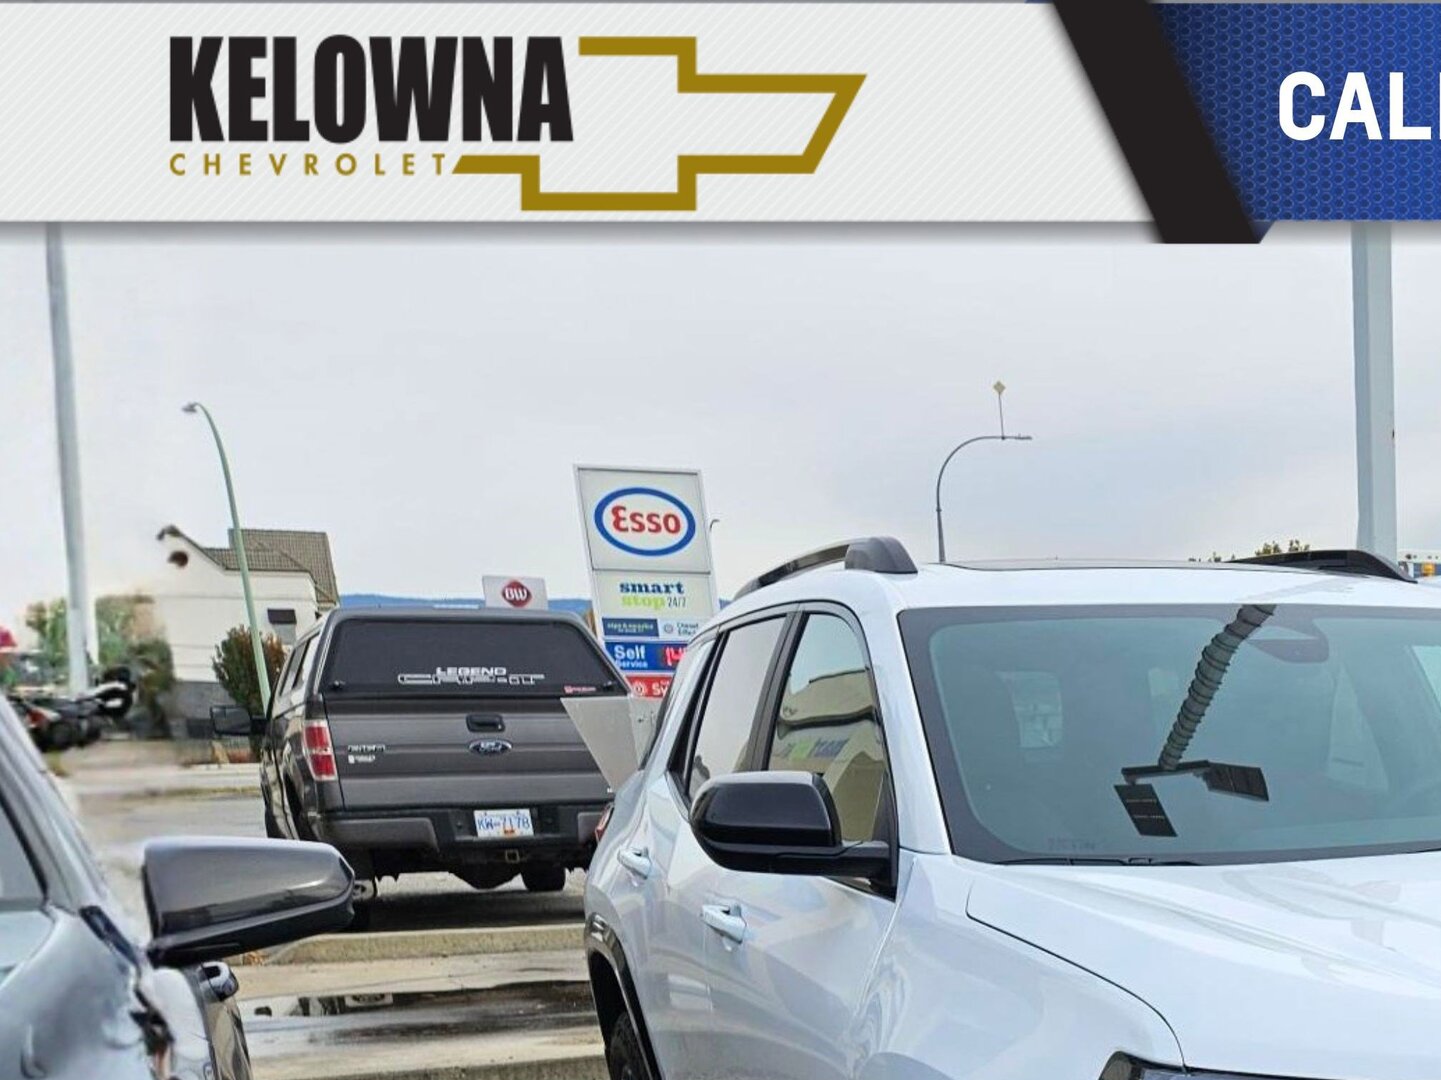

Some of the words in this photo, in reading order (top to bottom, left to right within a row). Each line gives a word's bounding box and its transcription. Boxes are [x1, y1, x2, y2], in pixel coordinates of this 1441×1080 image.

[619, 581, 685, 594] smart
[613, 645, 646, 660] Self
[436, 667, 507, 675] LEGEND
